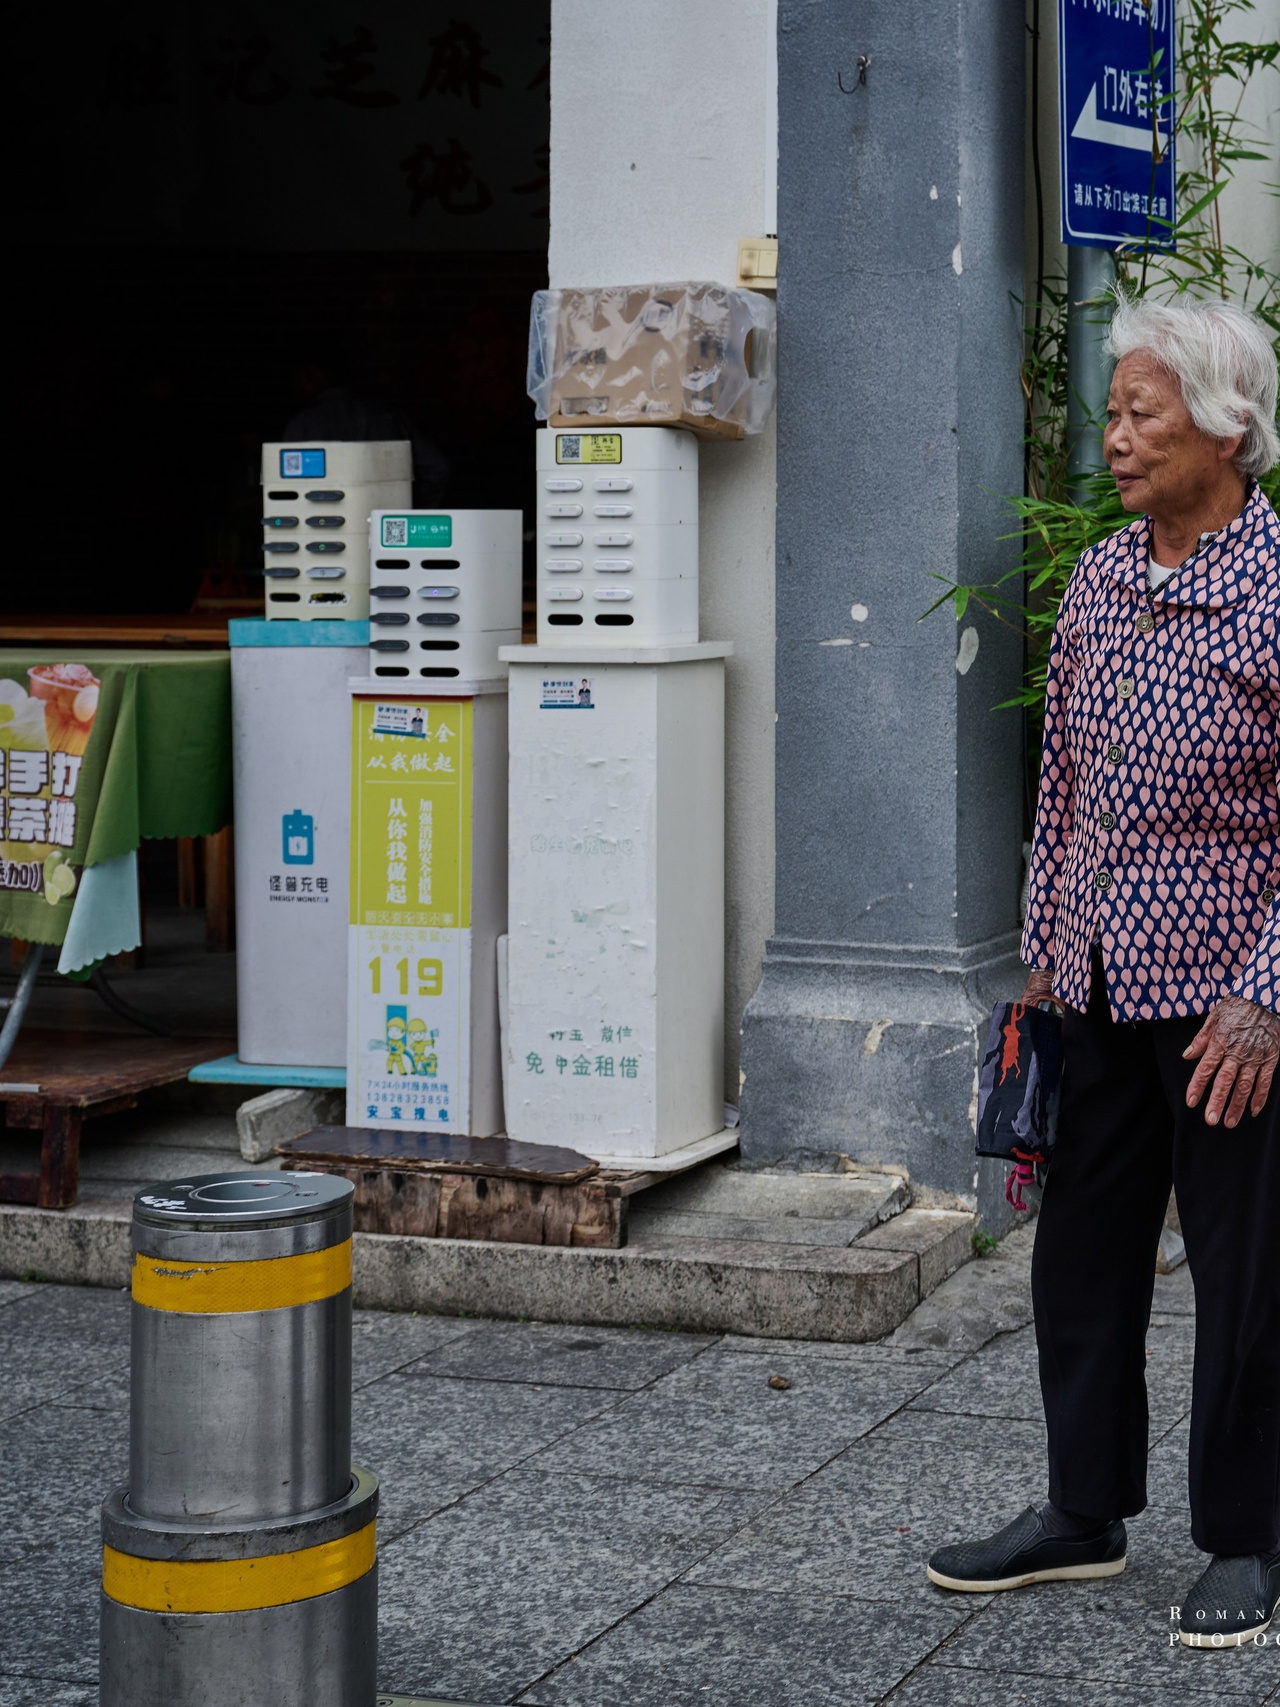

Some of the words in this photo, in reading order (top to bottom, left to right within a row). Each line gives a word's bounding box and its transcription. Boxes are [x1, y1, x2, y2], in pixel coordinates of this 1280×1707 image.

[96, 20, 549, 110] 胜记芝麻
[0, 748, 83, 798] 手打
[366, 751, 456, 774] 从我做起
[386, 797, 408, 905] 从你我做起
[269, 875, 329, 893] 怪兽充电
[369, 956, 443, 996] 119
